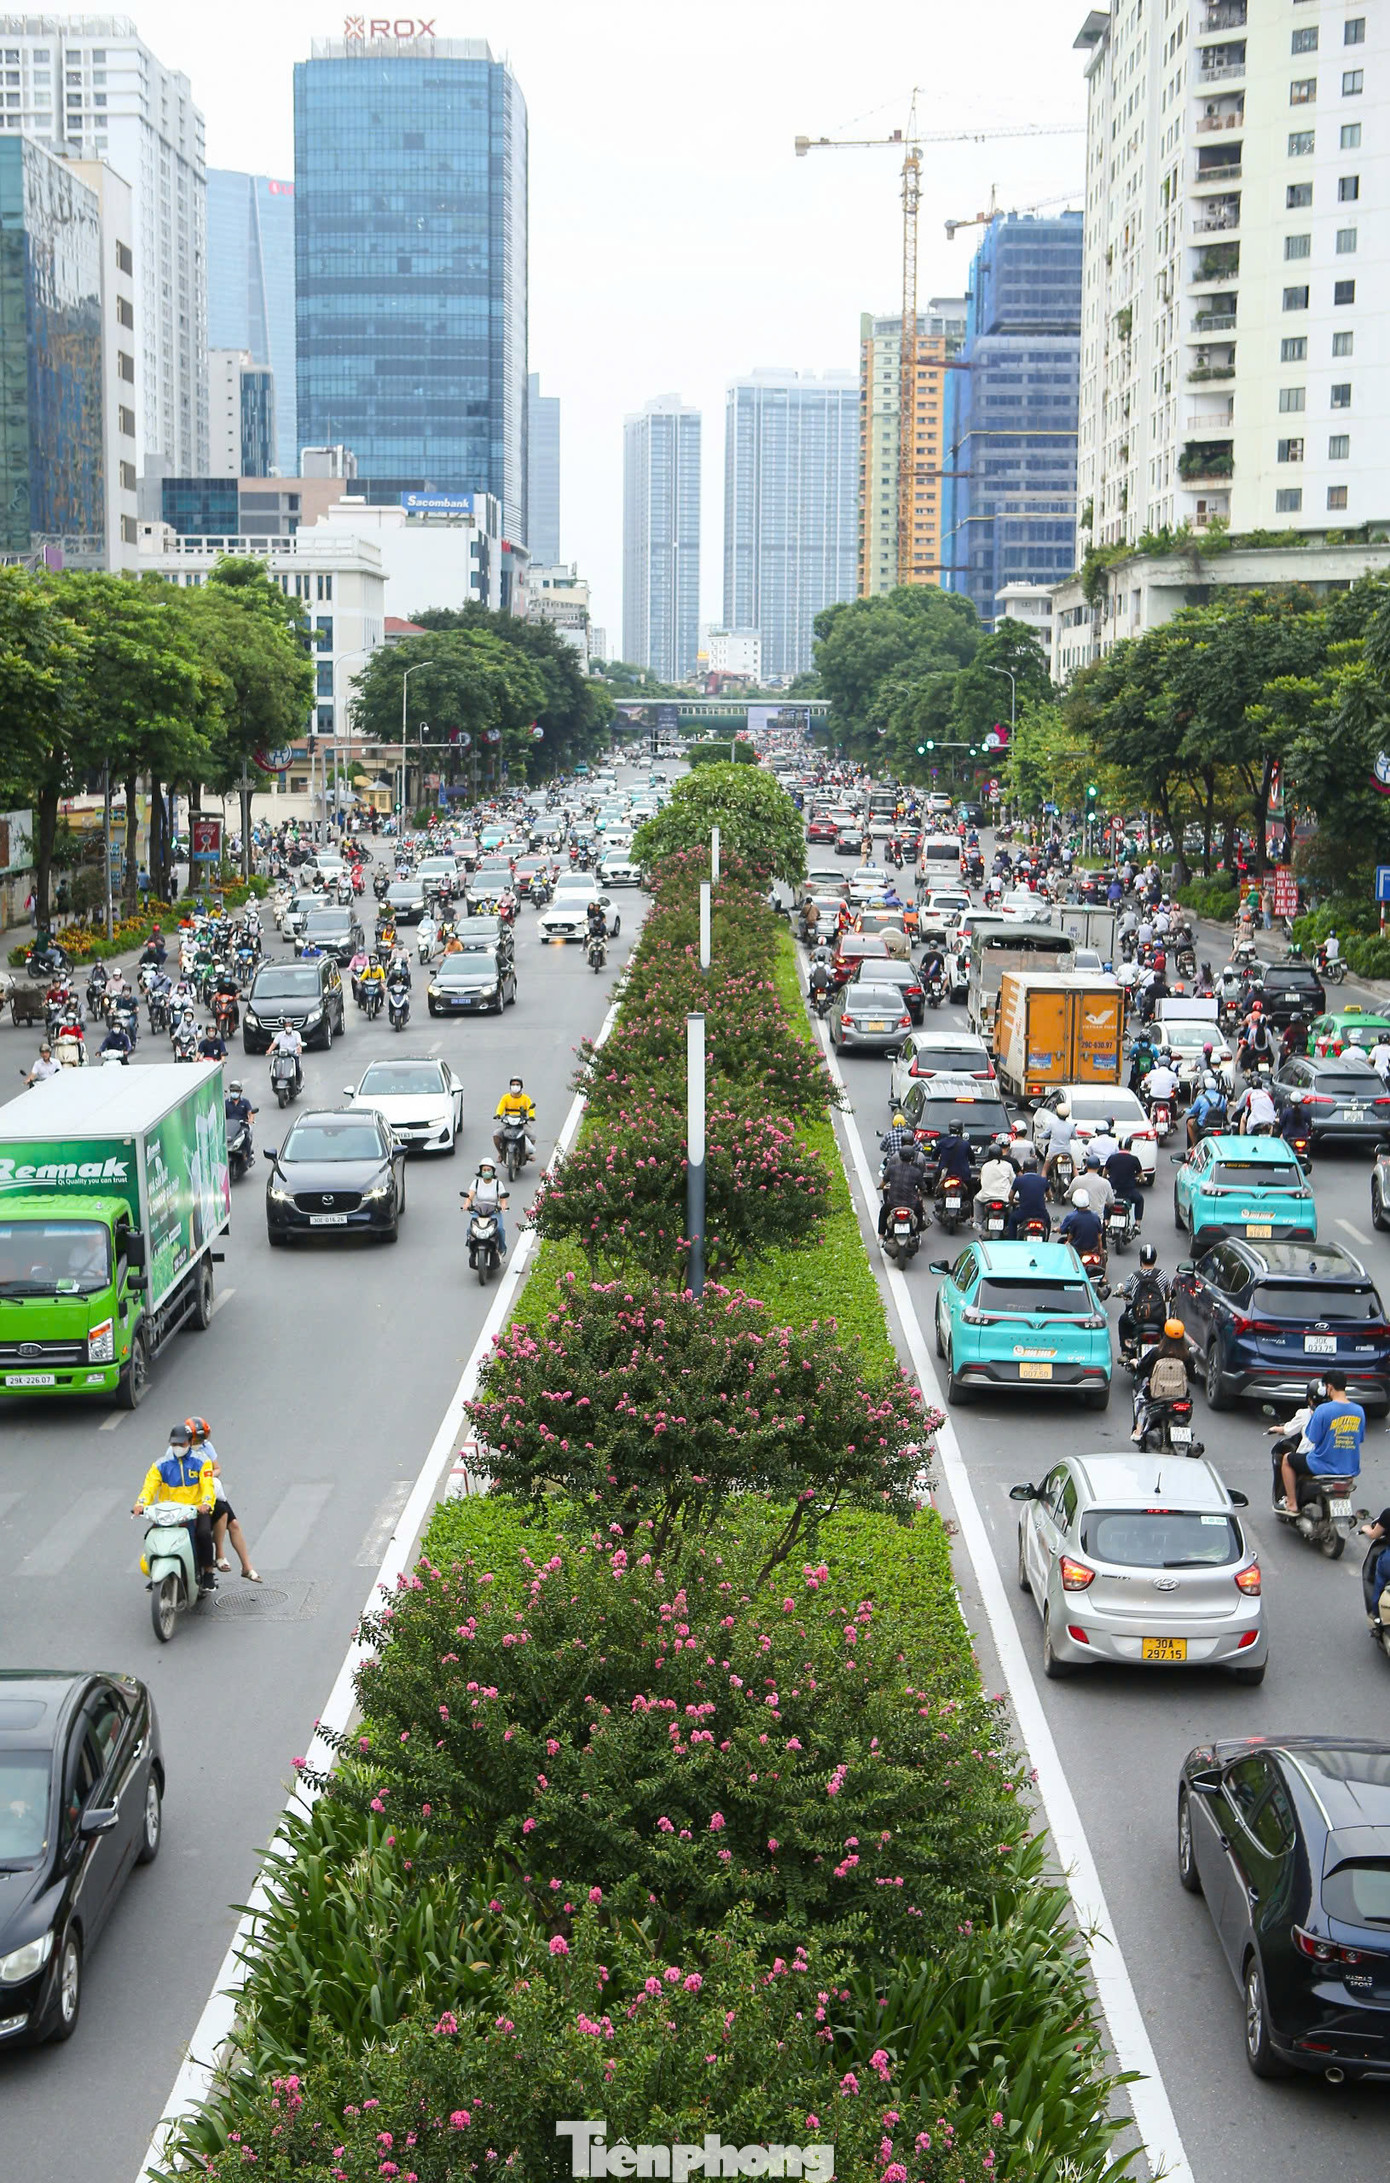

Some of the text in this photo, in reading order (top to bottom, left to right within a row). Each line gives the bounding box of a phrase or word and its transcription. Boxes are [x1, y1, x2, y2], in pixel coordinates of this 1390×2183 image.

[370, 19, 436, 39] ROX
[407, 495, 470, 508] Sacombank
[10, 1376, 51, 1385] 29K-226.07
[1155, 1638, 1174, 1649] 30A
[1147, 1649, 1182, 1660] 297.15
